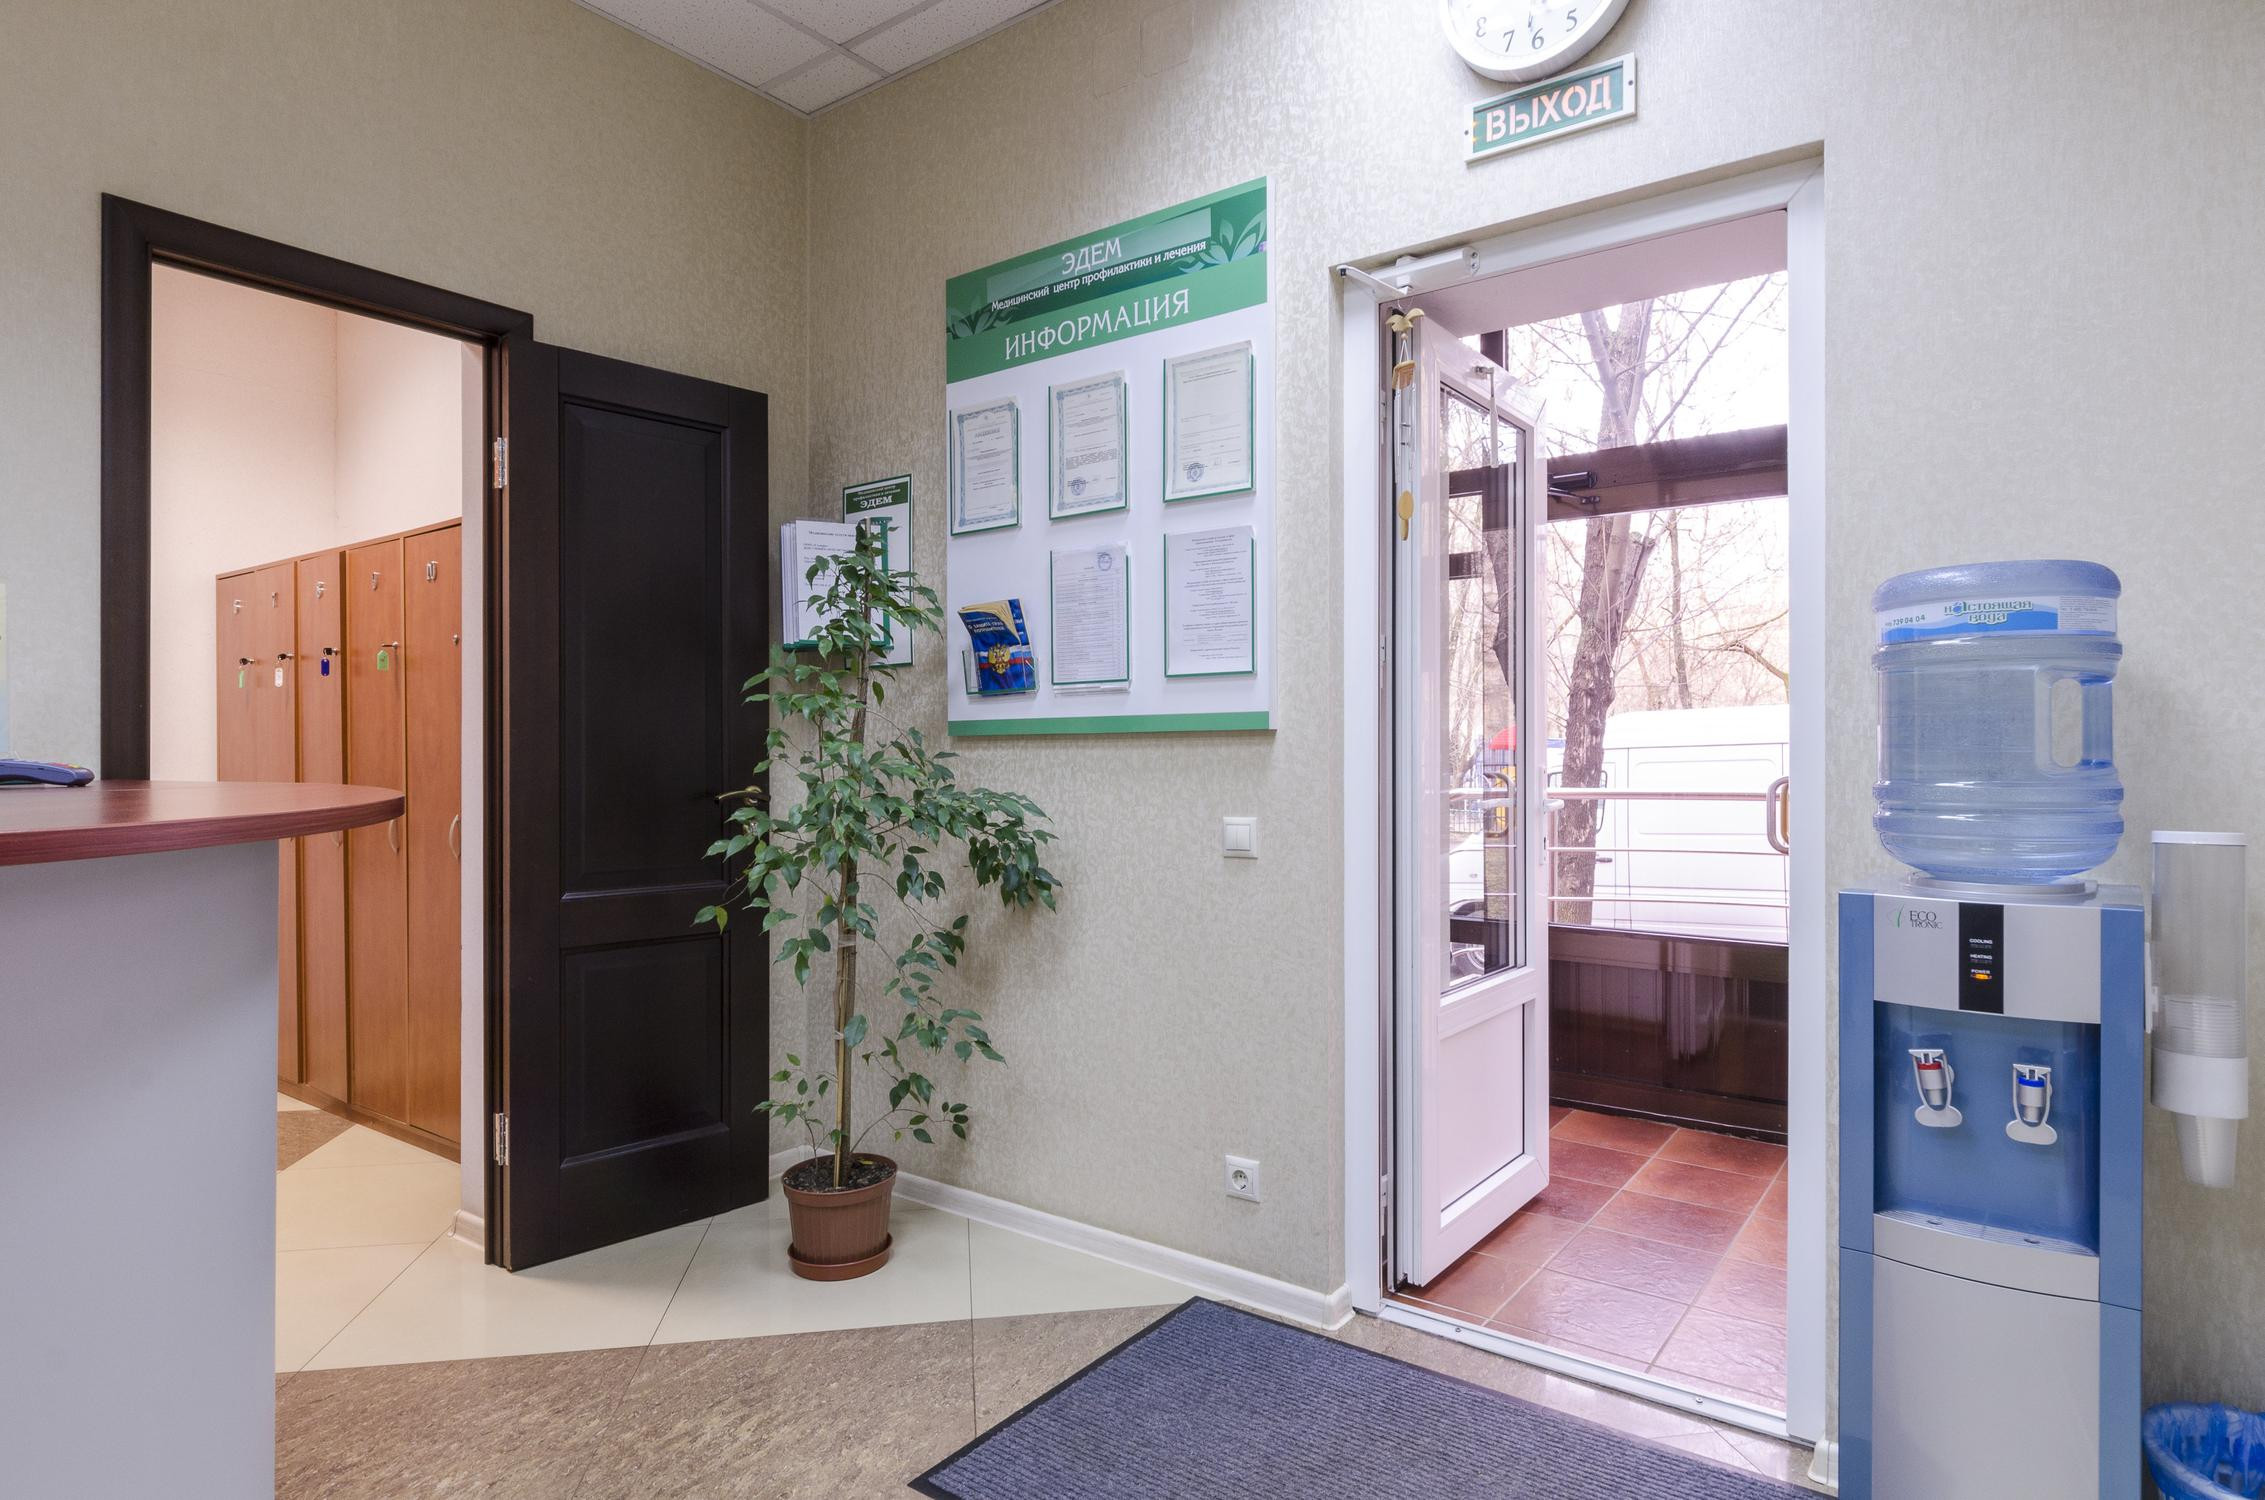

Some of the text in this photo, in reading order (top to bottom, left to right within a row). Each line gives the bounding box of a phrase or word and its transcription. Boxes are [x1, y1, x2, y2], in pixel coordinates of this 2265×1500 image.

[1565, 8, 1577, 32] 5
[1503, 30, 1515, 52] 7
[1531, 28, 1544, 50] 6
[1486, 75, 1613, 143] ВЫХОД
[1062, 237, 1122, 276] ЭДЕМ
[991, 241, 1207, 312] Медицинский центр профилактики и лечения
[1005, 288, 1190, 361] ИНФОРМАЦИЯ
[860, 495, 893, 509] ЭДЕМ
[1909, 910, 1937, 922] ECO
[1911, 921, 1943, 929] TRONIC
